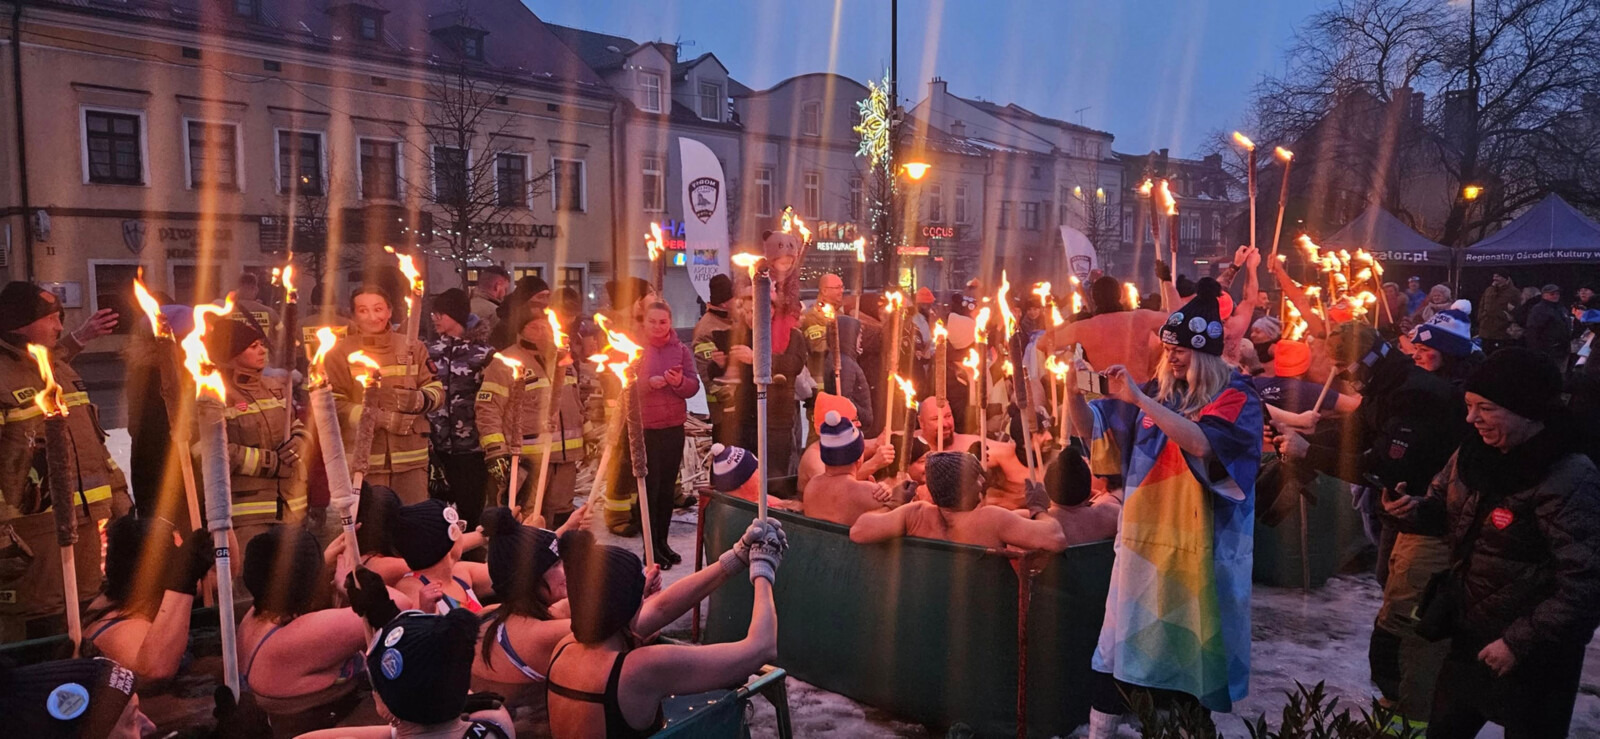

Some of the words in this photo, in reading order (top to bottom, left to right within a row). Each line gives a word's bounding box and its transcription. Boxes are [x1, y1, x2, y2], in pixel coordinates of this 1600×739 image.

[1373, 250, 1428, 263] zator.pl
[1466, 253, 1515, 262] Regionalny
[1556, 249, 1593, 259] Kultury
